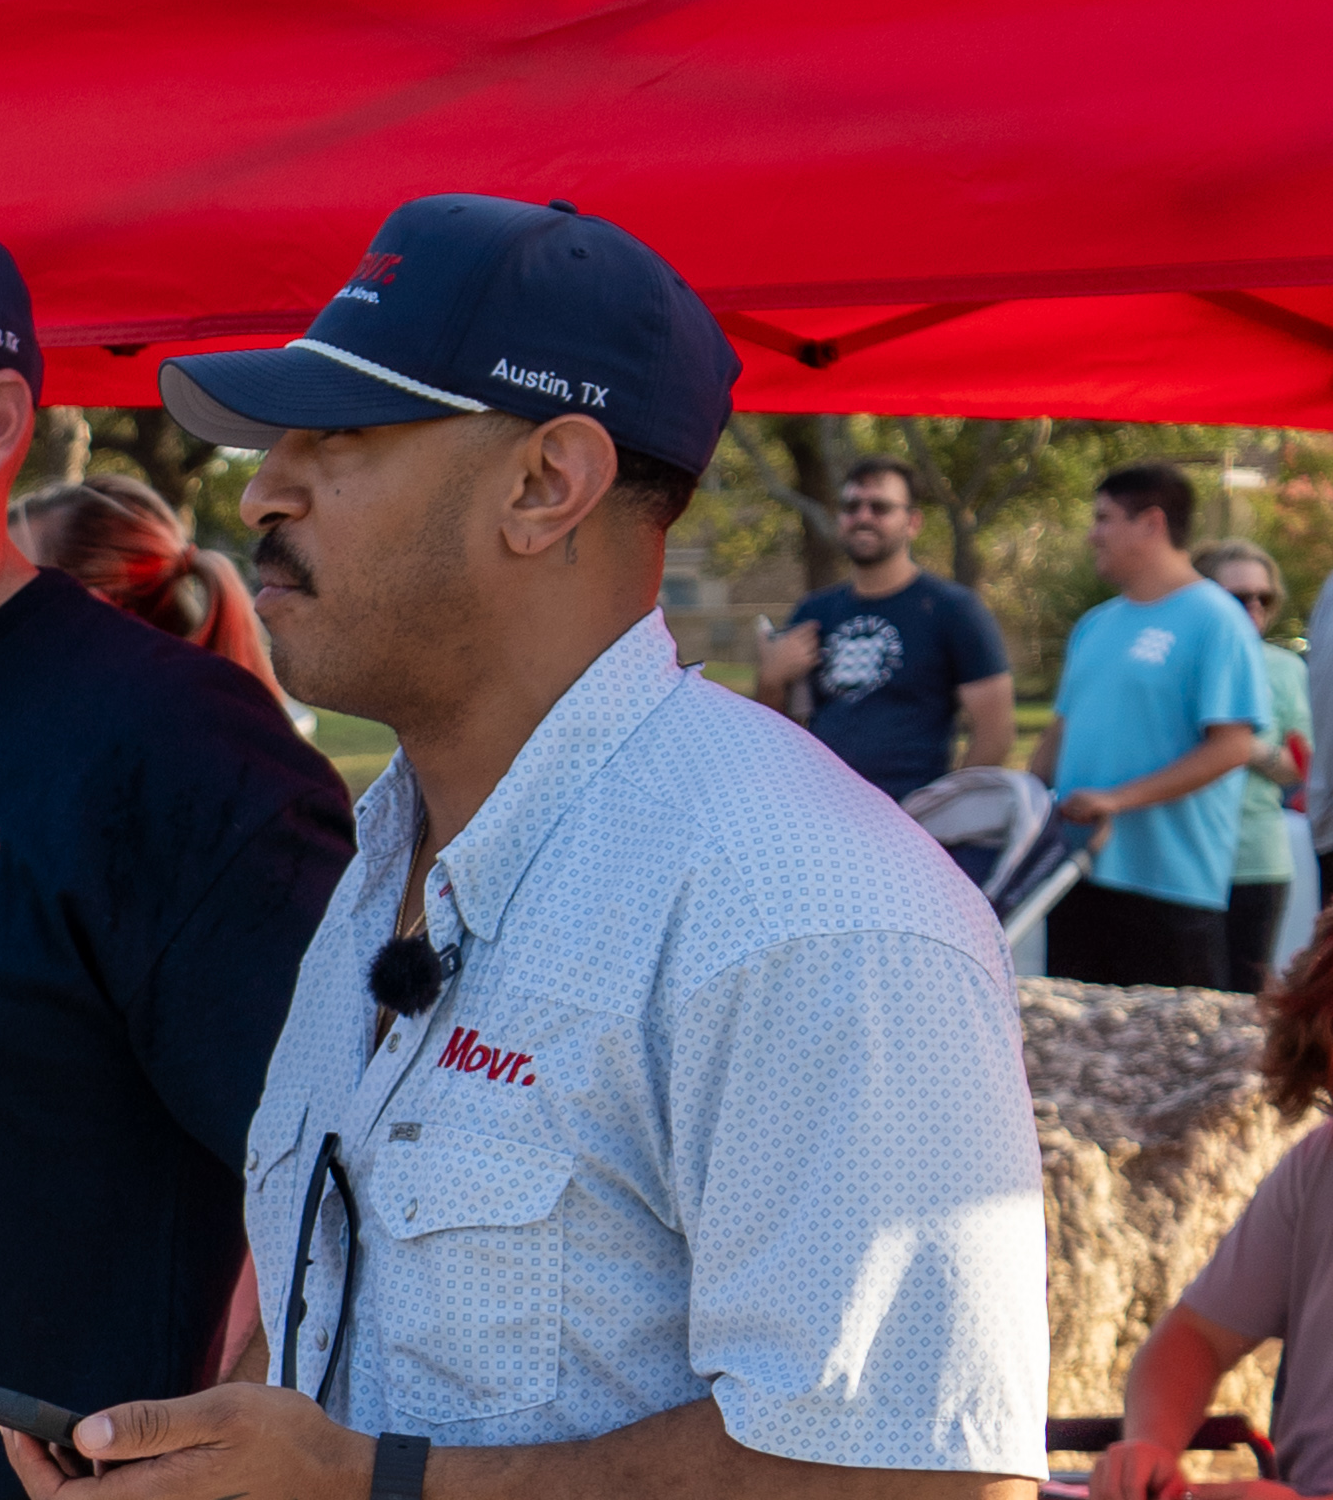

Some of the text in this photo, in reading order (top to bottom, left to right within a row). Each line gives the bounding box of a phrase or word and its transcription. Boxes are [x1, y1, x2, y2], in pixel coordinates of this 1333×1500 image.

[490, 357, 610, 408] Austin, TX
[436, 1025, 536, 1087] Movr.
